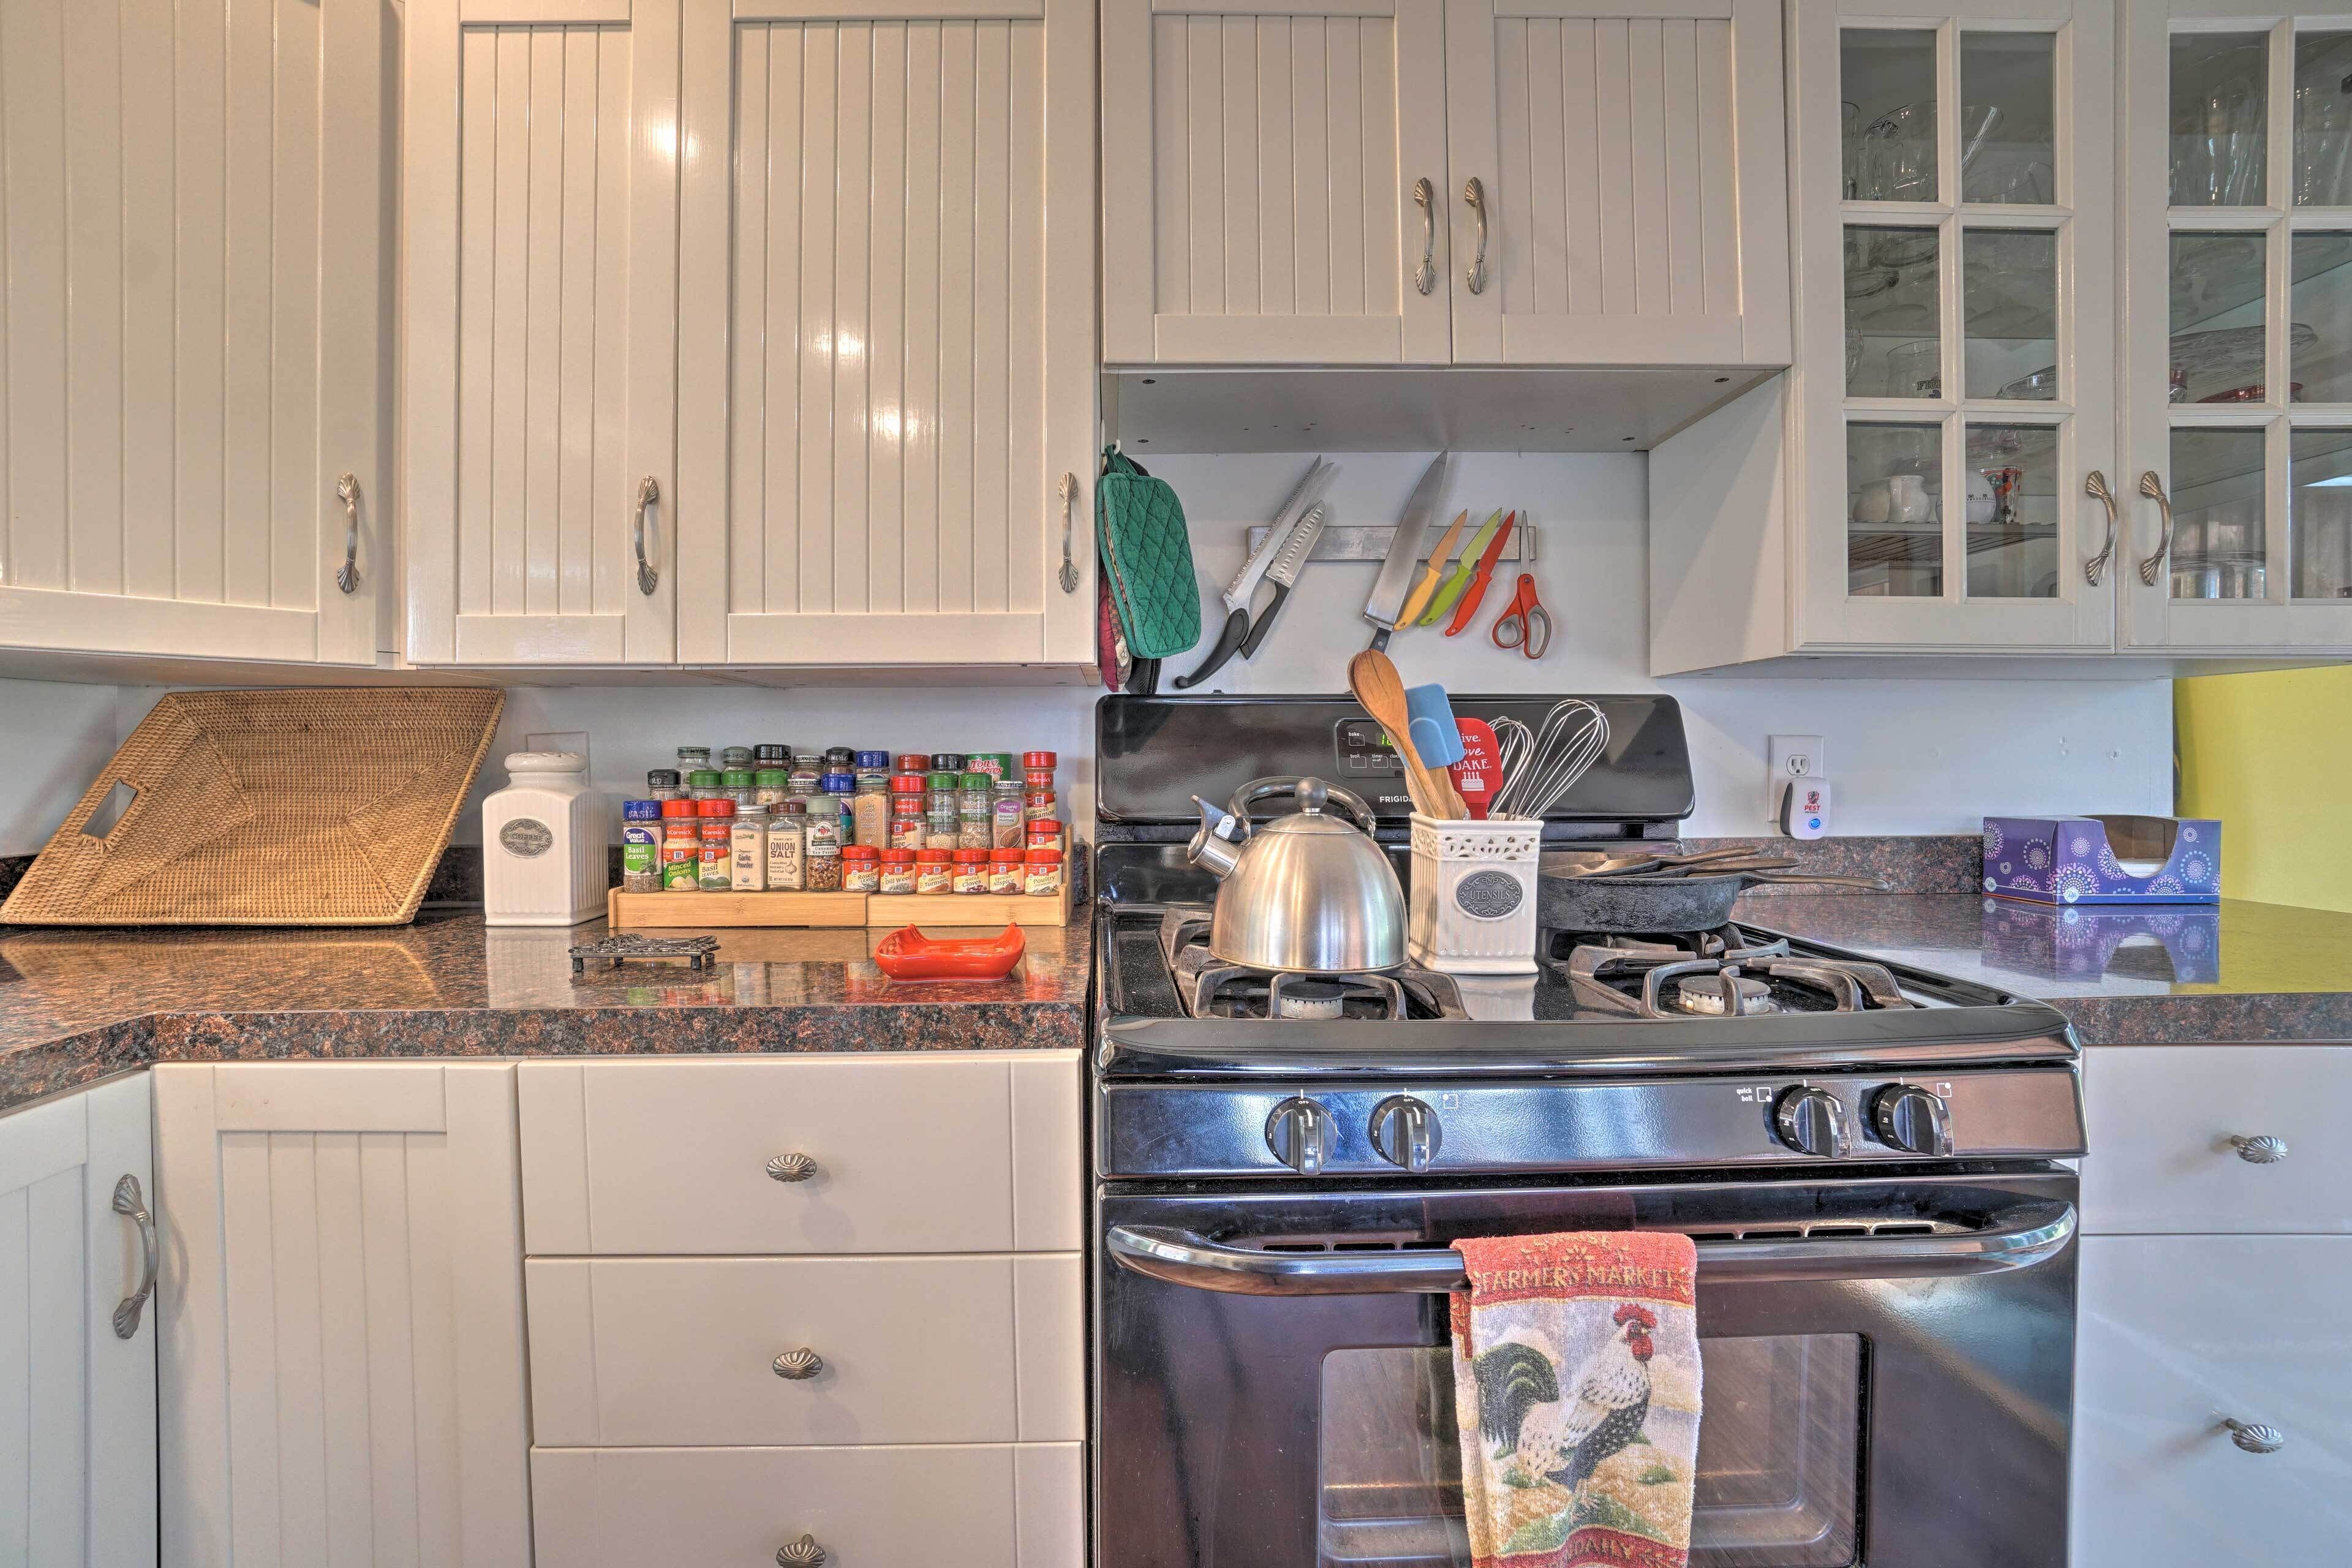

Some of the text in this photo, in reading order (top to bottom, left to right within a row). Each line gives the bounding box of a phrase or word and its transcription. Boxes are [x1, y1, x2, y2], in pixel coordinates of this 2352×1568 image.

[1461, 733, 1481, 743] ive.
[771, 842, 796, 853] ONION
[668, 861, 691, 872] Minced
[702, 864, 718, 873] Basil
[668, 868, 691, 877] Onions
[885, 874, 912, 885] Dill Weed
[924, 877, 949, 888] Turmeric
[993, 878, 1015, 888] Allspice
[1033, 875, 1056, 884] Poultry
[1470, 890, 1510, 900] UTENSILS
[1586, 1264, 1673, 1289] MARKET
